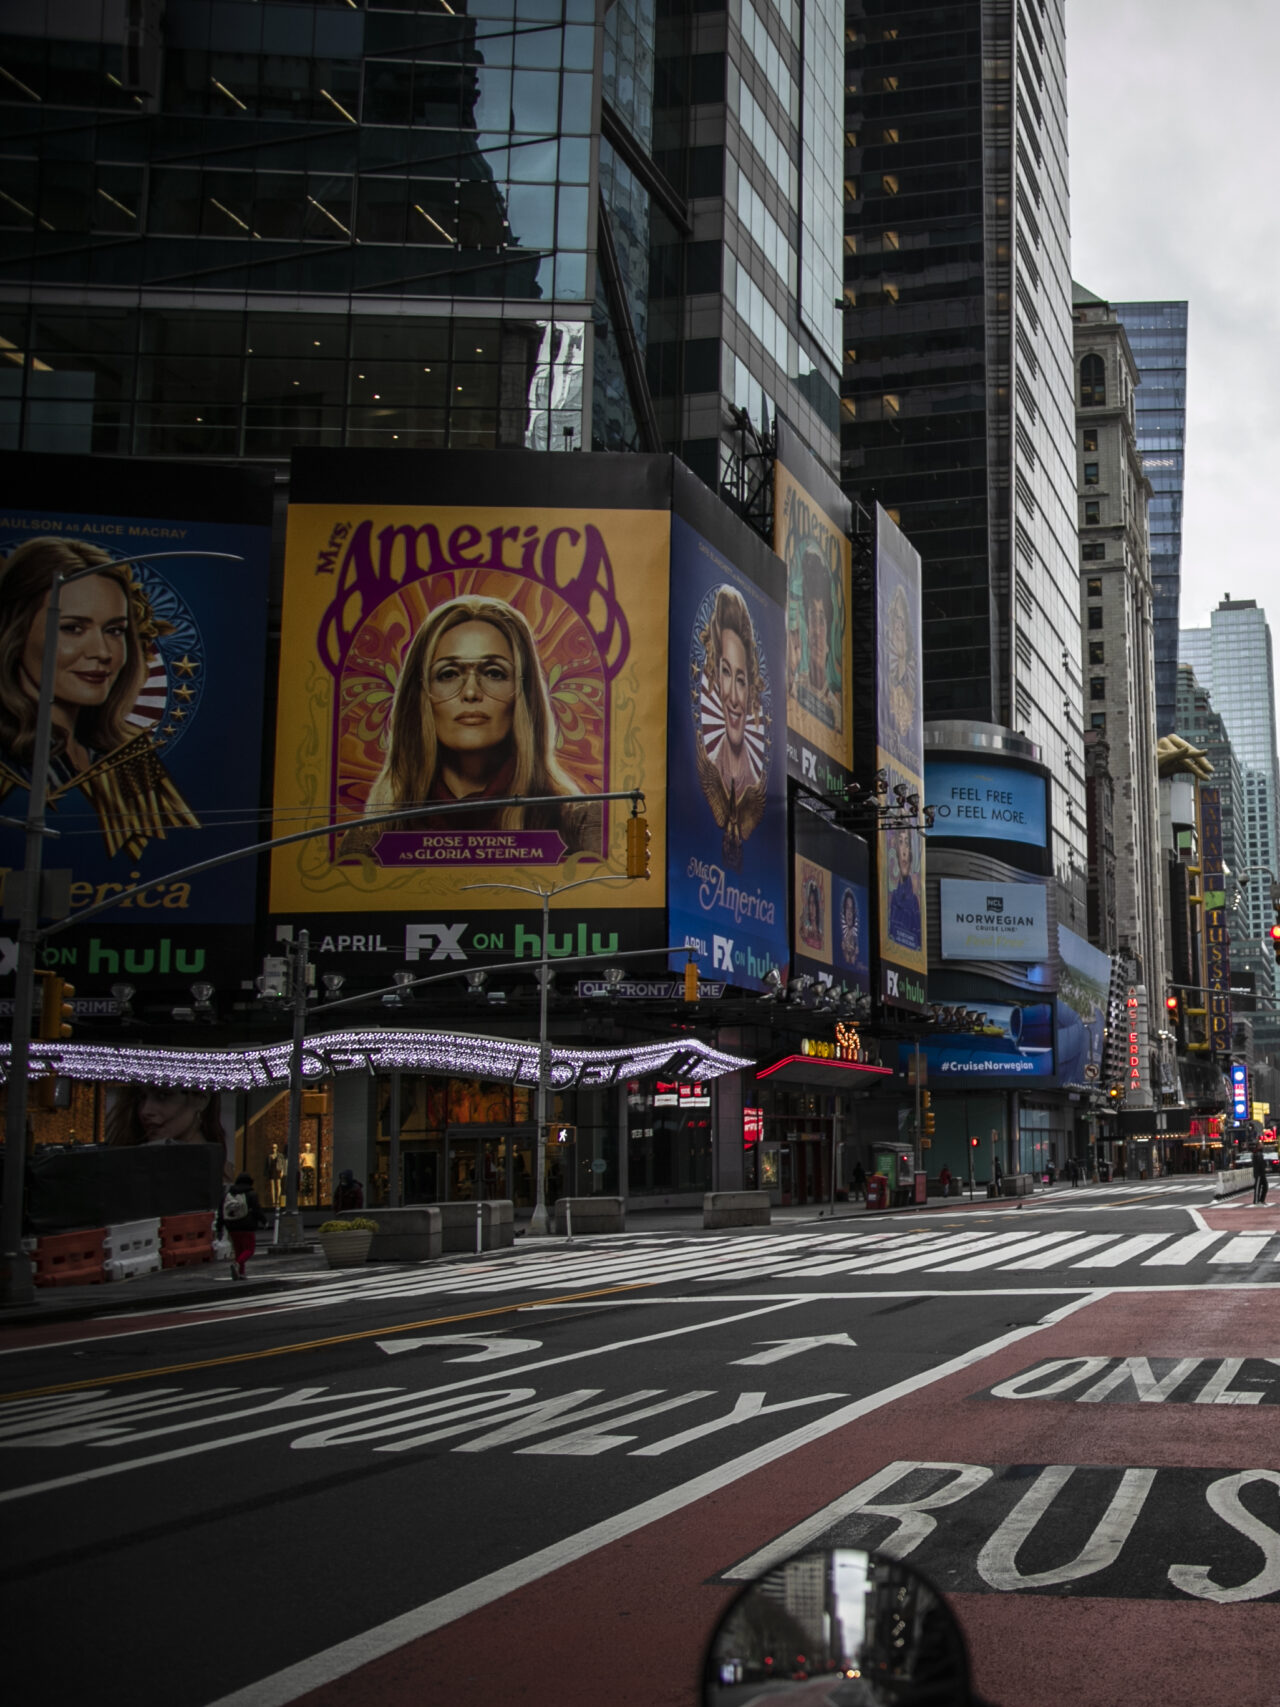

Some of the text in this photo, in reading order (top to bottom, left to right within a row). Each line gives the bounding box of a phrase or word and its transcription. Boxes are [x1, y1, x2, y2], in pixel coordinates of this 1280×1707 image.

[0, 517, 62, 532] AULSON
[82, 523, 124, 536] ALICE
[128, 525, 188, 540] MACRAY
[802, 746, 817, 782] FX
[951, 787, 1013, 805] FEEL FREE
[957, 805, 987, 820] FEEL
[991, 809, 1027, 825] MORE.
[414, 849, 472, 861] GLORIA
[476, 847, 544, 860] STEINEM
[422, 836, 517, 848] ROSE BYRNE
[699, 864, 775, 925] America
[956, 913, 1034, 926] NORWEGIAN
[42, 947, 78, 966] ON
[88, 938, 206, 974] hulu
[319, 923, 619, 961] APRIL FX ON hulu
[713, 934, 734, 973] FX
[1127, 986, 1140, 1090] AMSTERDAM
[941, 1060, 1034, 1073] #CruiseNorwegian
[290, 1388, 852, 1456] ONLY
